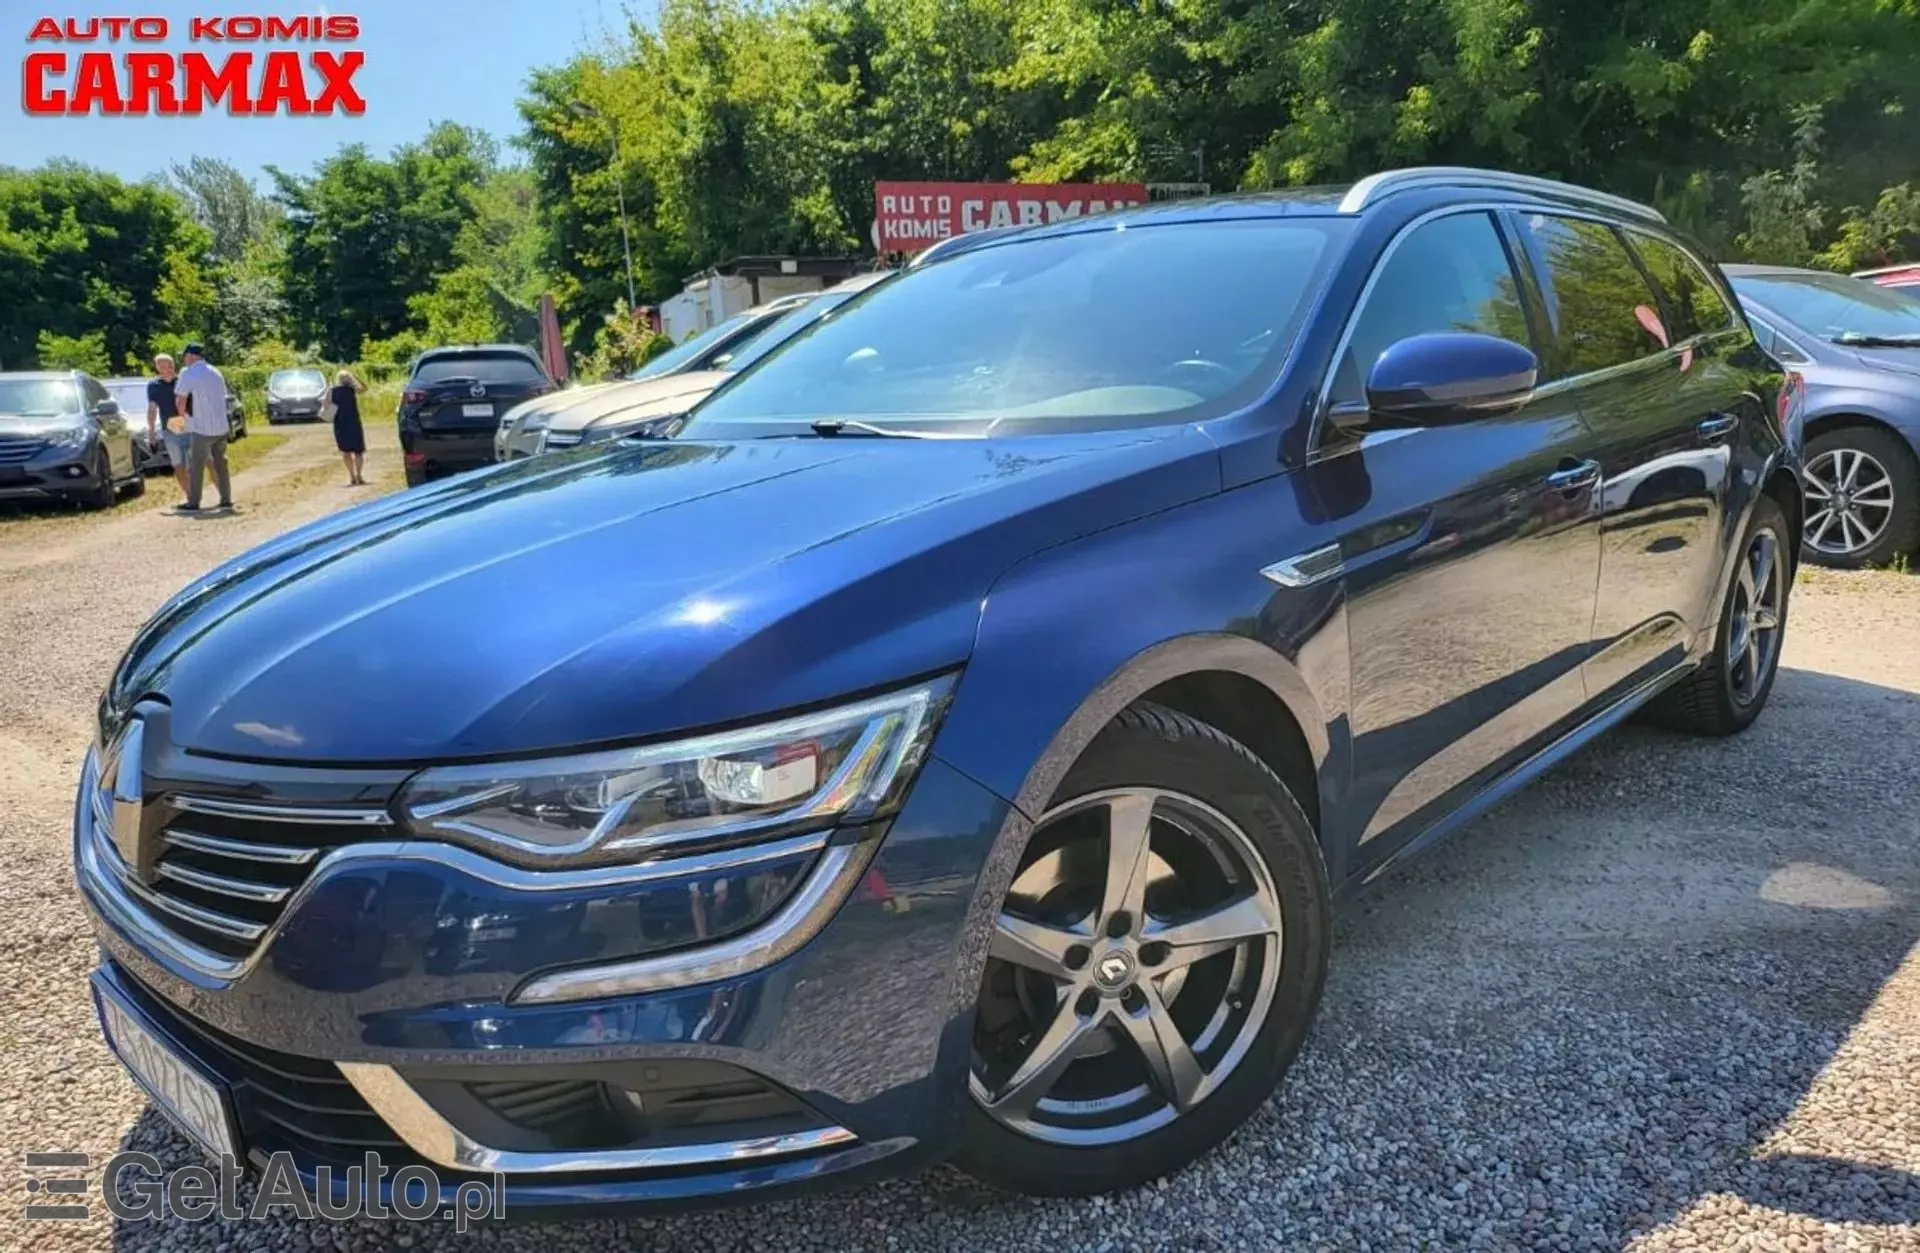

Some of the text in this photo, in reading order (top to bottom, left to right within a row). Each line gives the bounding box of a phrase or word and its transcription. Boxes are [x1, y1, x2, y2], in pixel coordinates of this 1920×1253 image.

[883, 195, 951, 214] AUTO
[961, 200, 1138, 233] CARM
[884, 218, 951, 239] KOMIS
